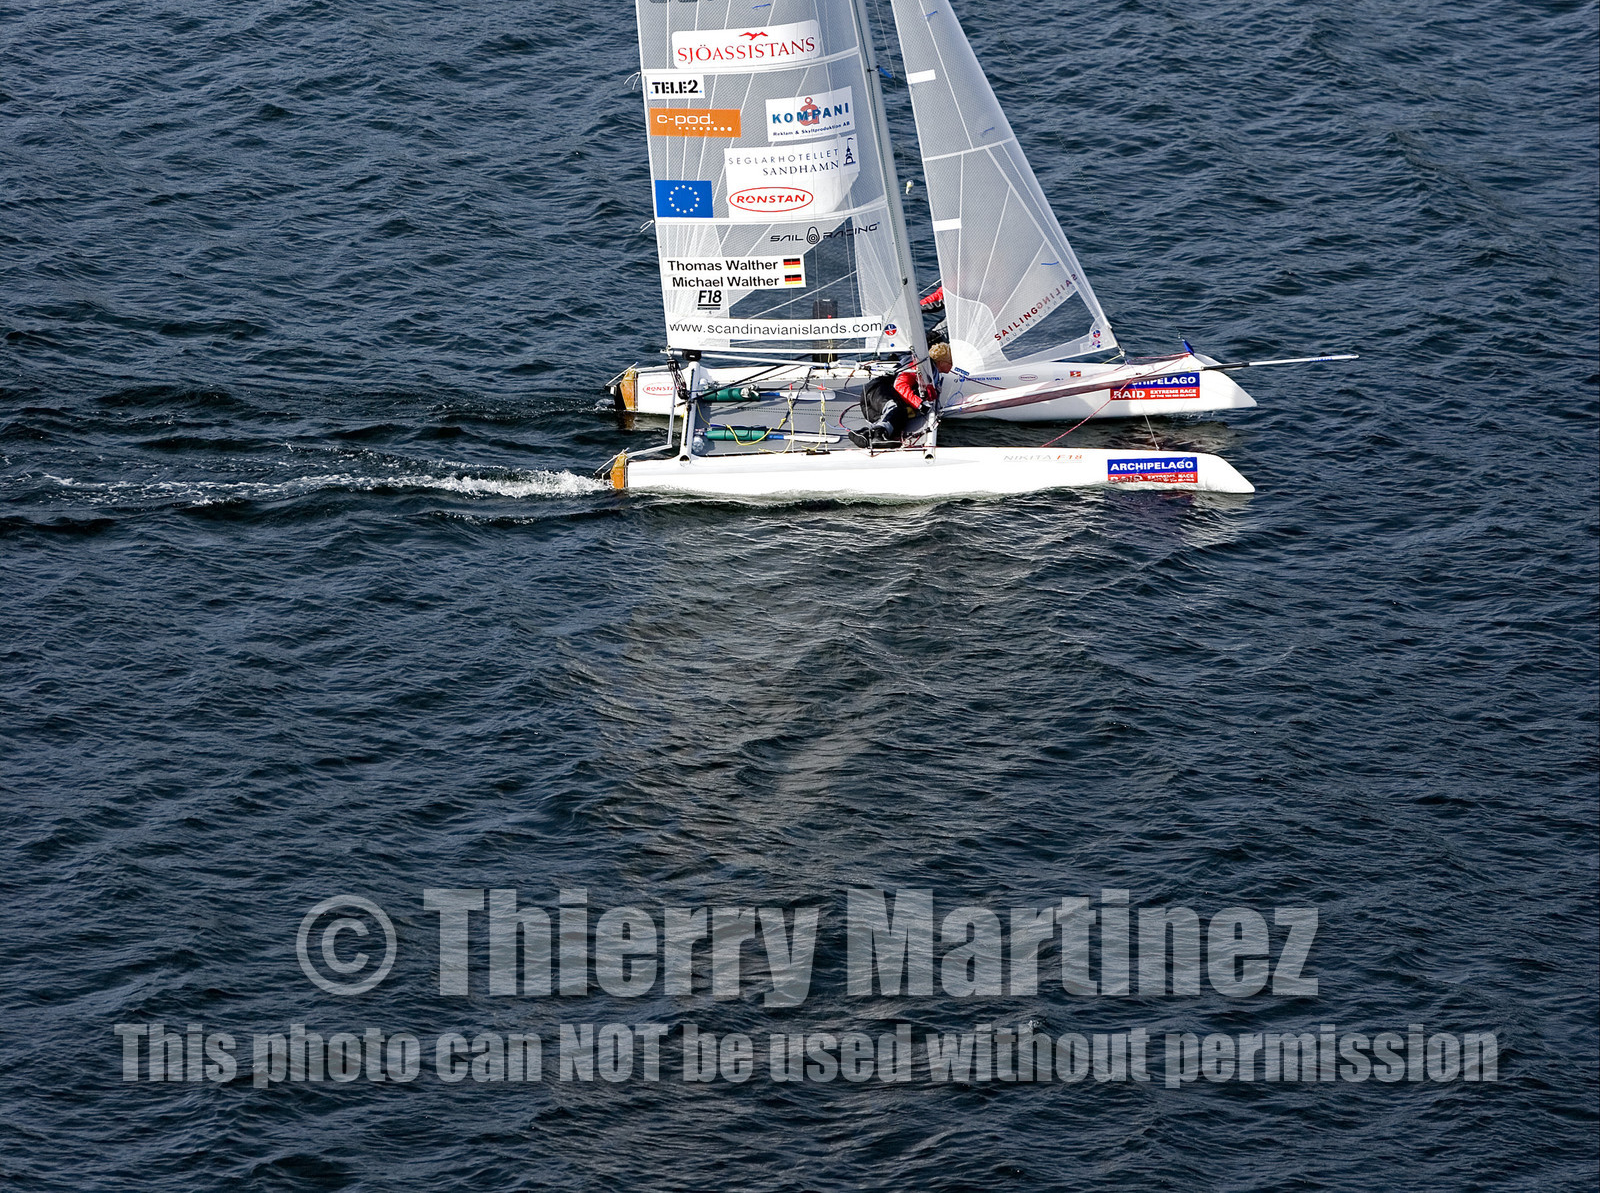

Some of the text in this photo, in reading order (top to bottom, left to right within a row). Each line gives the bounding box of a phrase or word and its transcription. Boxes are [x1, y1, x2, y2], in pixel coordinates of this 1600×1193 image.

[677, 37, 816, 64] SJÖASSISTANS
[772, 102, 849, 124] KOMPANI
[728, 148, 838, 165] SEGLARHOTELLET
[763, 160, 839, 176] SANDHAMN
[736, 194, 805, 203] RONSTAN
[823, 223, 878, 239] RACING
[667, 260, 778, 271] Thomas Walther
[672, 275, 779, 288] Michael Walther
[698, 290, 722, 303] F18
[669, 321, 882, 335] www.scandinavianislands.com
[994, 307, 1038, 341] SAILING
[1113, 390, 1146, 398] RAID
[1110, 461, 1193, 471] ARCHIPELAGO
